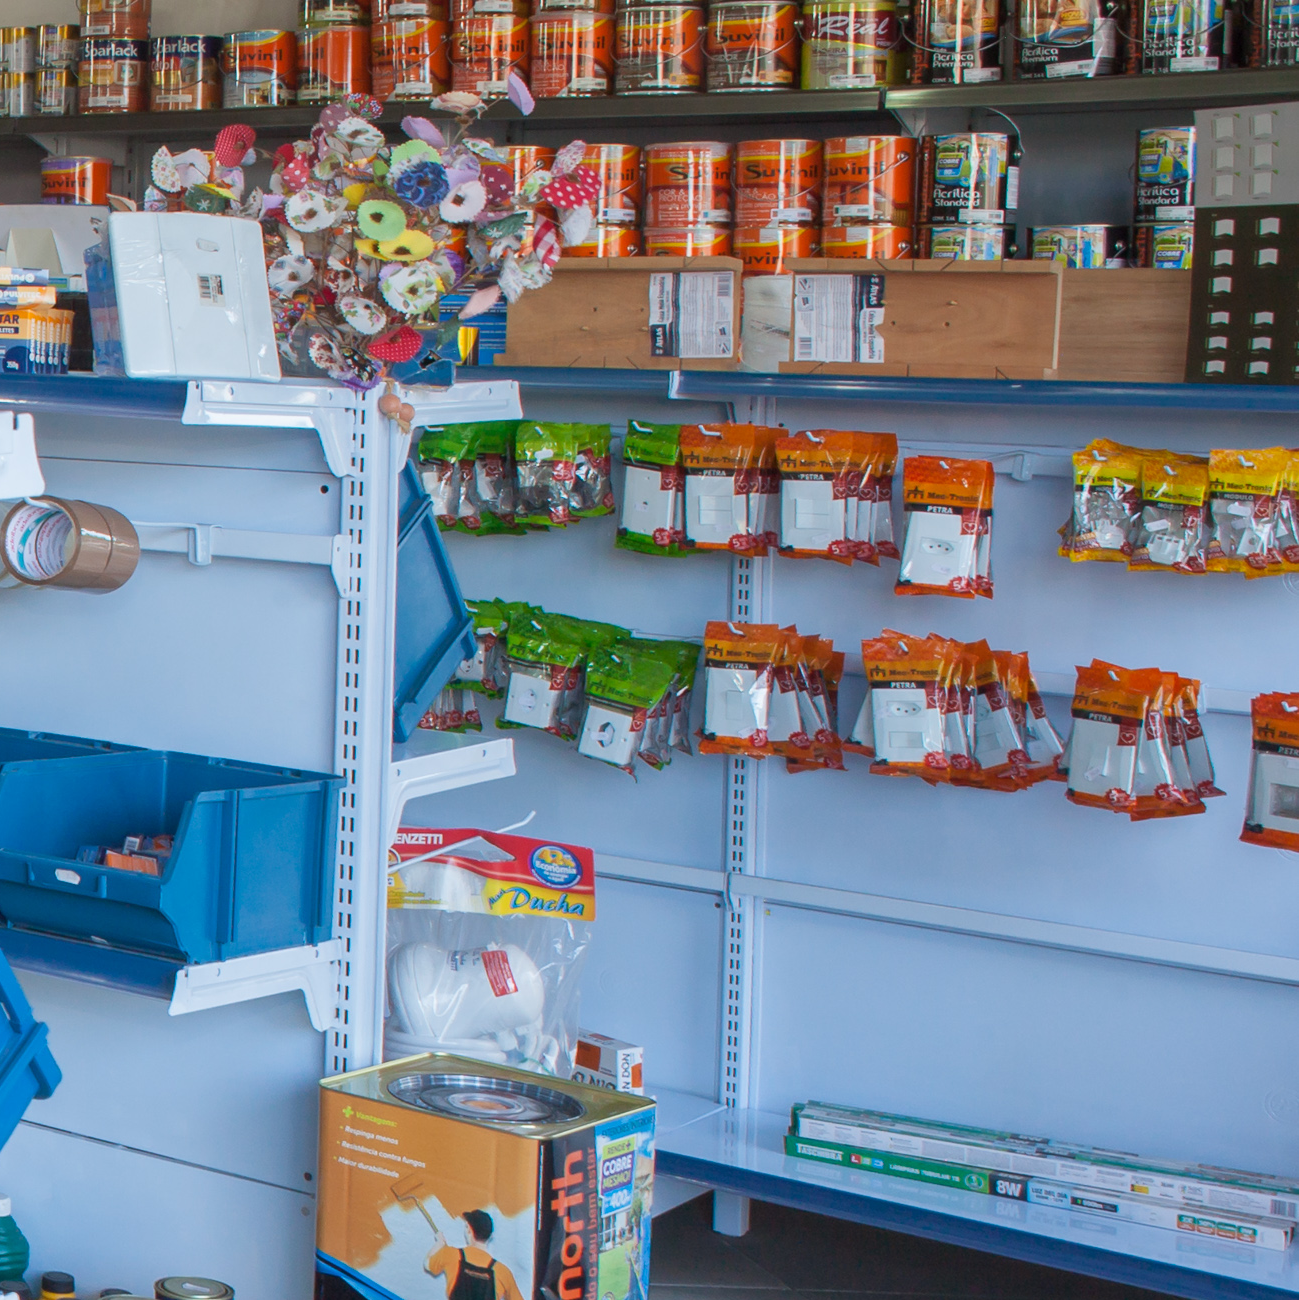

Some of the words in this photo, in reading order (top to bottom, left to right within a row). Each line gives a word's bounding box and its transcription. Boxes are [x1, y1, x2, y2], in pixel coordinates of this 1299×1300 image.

[538, 37, 605, 52] Suvinil
[619, 32, 686, 49] Suvinil
[714, 29, 784, 45] Suvinil
[85, 44, 137, 58] Sparlack
[459, 39, 525, 55] Suvinil
[938, 158, 964, 166] COBRE
[744, 163, 818, 179] Suvinil
[933, 188, 980, 199] Acrílica
[1137, 186, 1179, 197] Acrílica
[934, 199, 980, 207] Standard
[1137, 195, 1179, 205] Standard
[3, 291, 41, 299] PULVITEC
[869, 284, 880, 305] ATLAS
[655, 327, 664, 348] ATLAS
[928, 492, 980, 502] Mec-Tronic
[926, 506, 953, 514] PETRA
[889, 668, 938, 677] Mec-Tronic
[1089, 714, 1113, 723] PETRA
[394, 833, 443, 845] ENZETTI
[507, 887, 584, 916] Ducha
[344, 1125, 375, 1140] Respinga
[376, 1134, 399, 1146] menos
[341, 1140, 377, 1157] Resistência
[378, 1148, 401, 1160] contra
[402, 1153, 426, 1168] fungos
[338, 1155, 356, 1168] Maior
[357, 1159, 400, 1178] durabilidade
[586, 1147, 595, 1189] estar
[603, 1154, 632, 1175] COBRE
[796, 1143, 843, 1161] TASCHIBRA
[996, 1180, 1021, 1197] 8W
[603, 1172, 631, 1189] MESMO!
[587, 1194, 597, 1229] bem
[589, 1232, 598, 1264] seu
